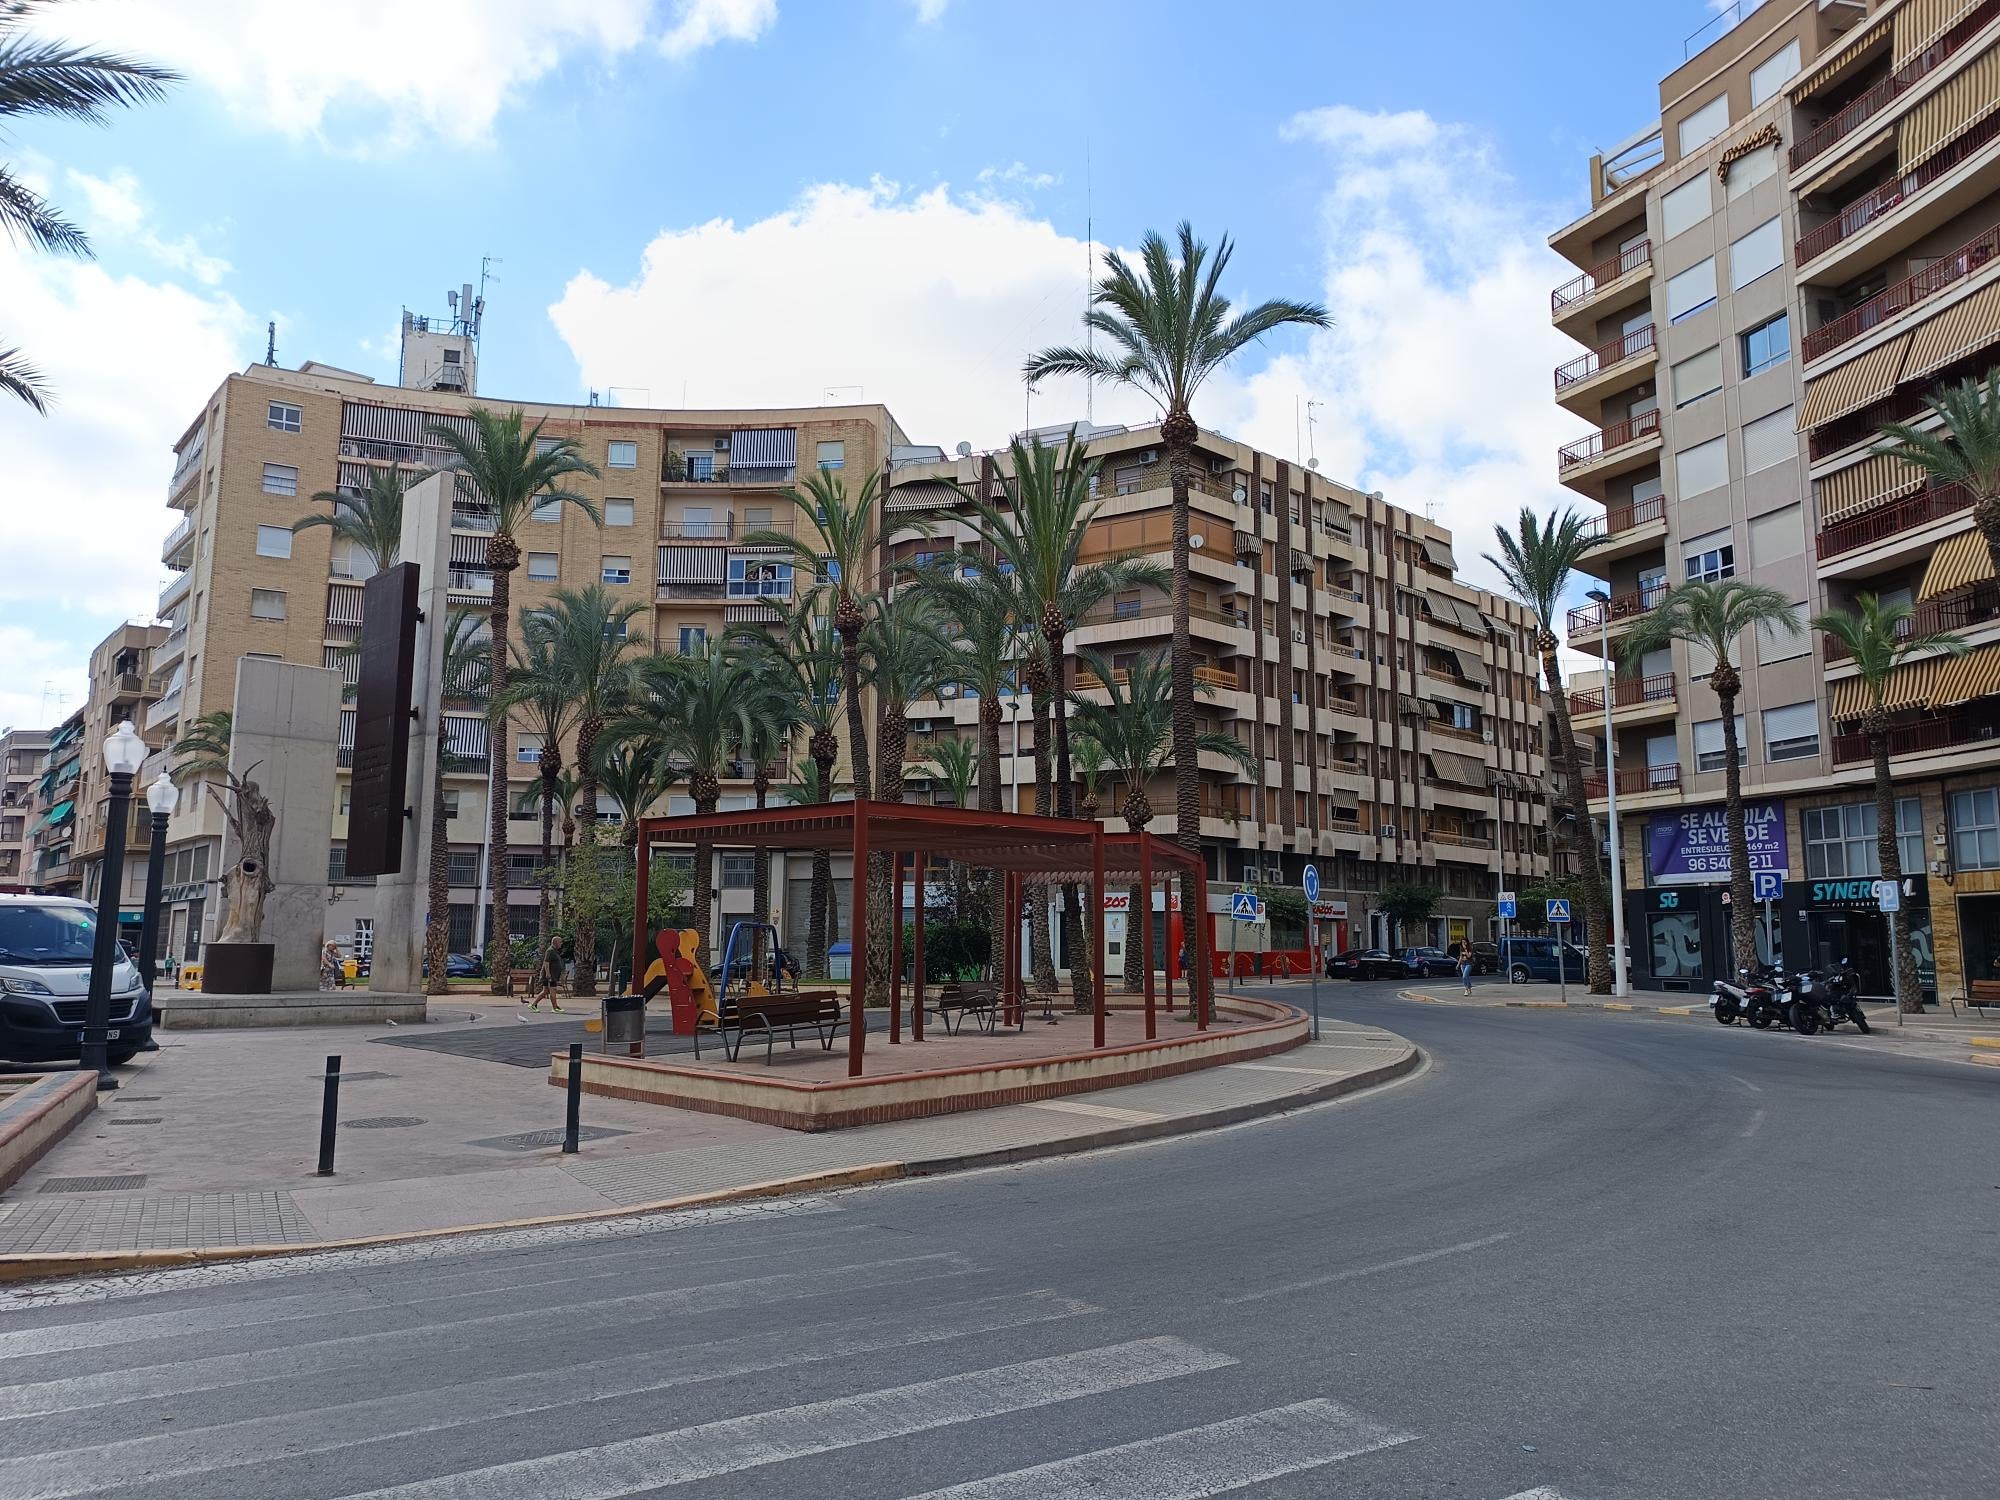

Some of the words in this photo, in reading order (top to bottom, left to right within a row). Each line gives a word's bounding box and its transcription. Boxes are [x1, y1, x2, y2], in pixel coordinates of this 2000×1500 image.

[1680, 813, 1700, 830] SE
[1702, 806, 1777, 828] ALILA
[1688, 828, 1708, 845] SE
[1709, 824, 1769, 843] VEDE
[1765, 841, 1779, 850] m2
[1688, 858, 1706, 871] 96
[1761, 854, 1773, 868] 11
[1760, 874, 1776, 894] P
[1813, 879, 1916, 900] SYNERG
